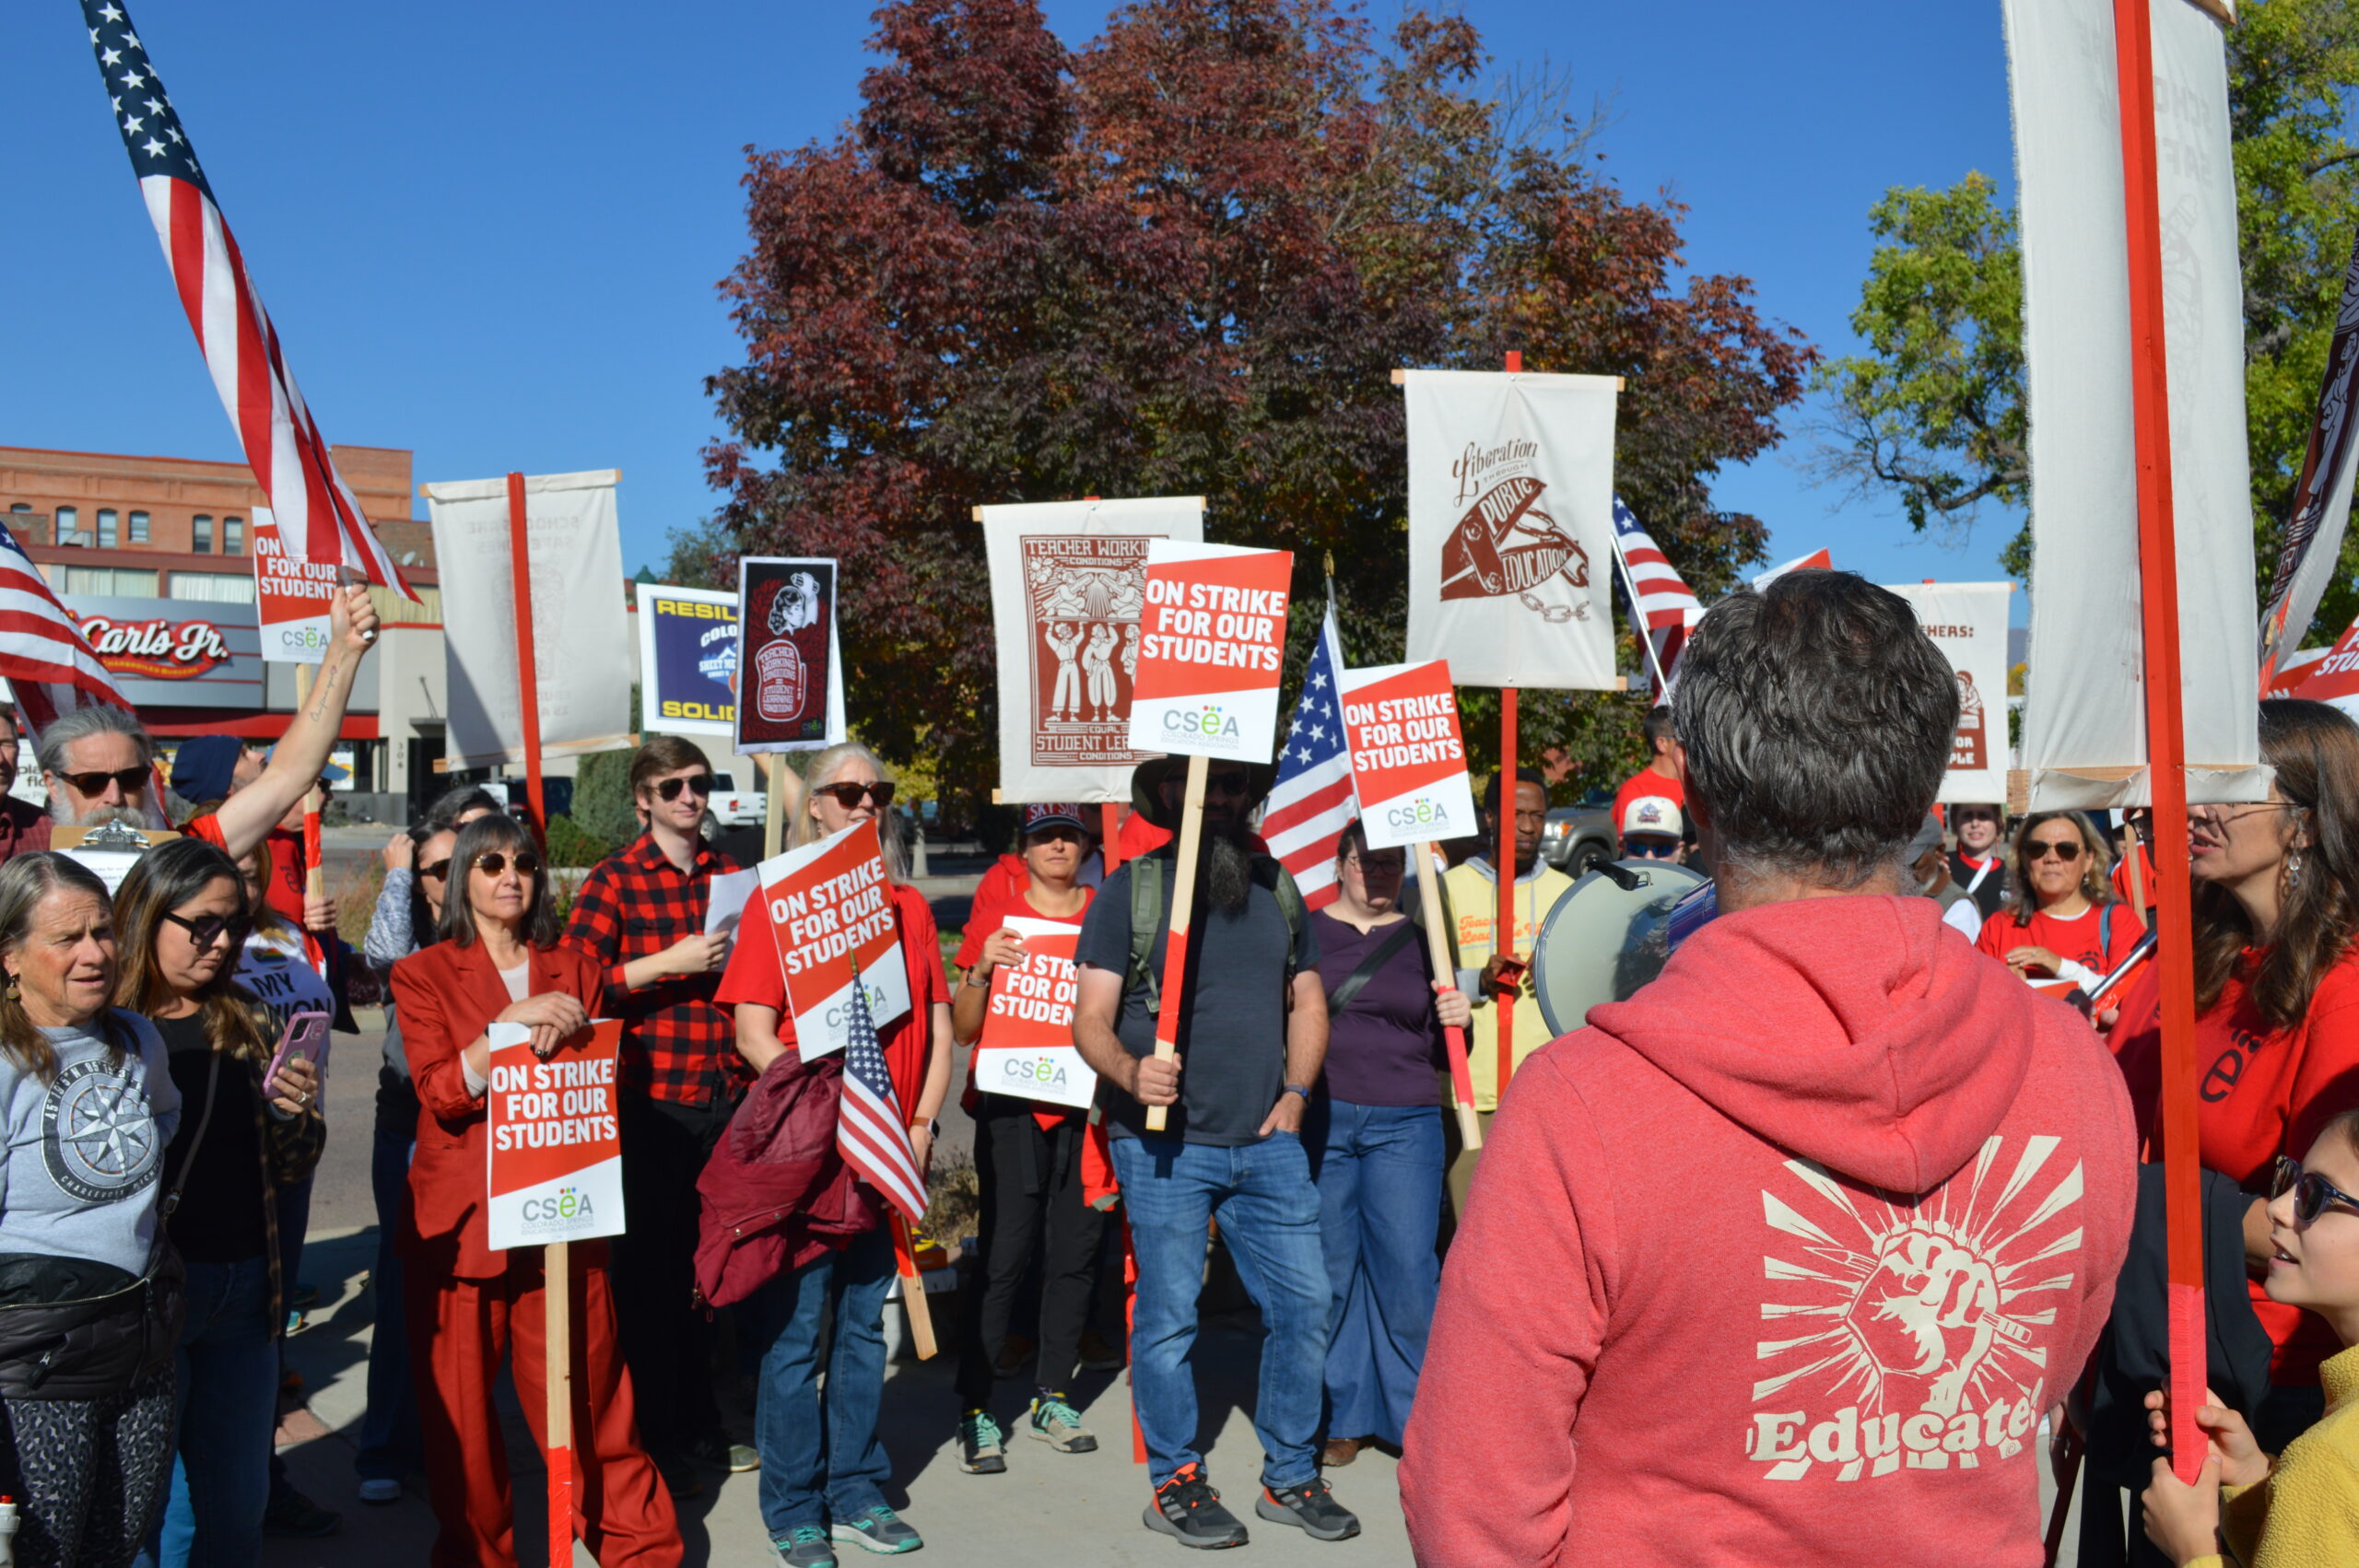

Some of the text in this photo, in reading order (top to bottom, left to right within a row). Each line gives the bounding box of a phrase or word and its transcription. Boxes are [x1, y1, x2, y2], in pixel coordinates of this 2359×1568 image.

[1452, 439, 1538, 508] Liberation
[1483, 463, 1529, 484] THROUGH
[1478, 478, 1532, 535] PUBLIC
[256, 536, 281, 556] ON
[1026, 539, 1093, 556] TEACHER
[1069, 557, 1122, 567] CONDITIONS
[266, 557, 337, 582] FOR OUR
[1502, 548, 1567, 592] EDUCATION
[261, 577, 337, 601] STUDENT
[1146, 579, 1286, 617] ON STRIKE
[80, 618, 229, 661] Carl's Jr.
[1157, 607, 1274, 644] FOR OUR
[1143, 634, 1280, 673] STUDENTS
[1344, 693, 1455, 727] ON STRIKE
[1036, 735, 1102, 751] STUDENT
[1088, 725, 1120, 734] EQUAL
[1359, 717, 1452, 748] FOR OUR
[1079, 752, 1133, 761] CONDITIONS
[1354, 739, 1463, 772] STUDENTS
[1030, 802, 1055, 820] SKY
[770, 855, 886, 924] ON STRIKE
[790, 885, 885, 946] FOR OUR
[785, 907, 894, 975] STUDENTS
[1033, 954, 1079, 982] STR
[250, 973, 296, 997] MY
[1005, 972, 1052, 1000] FOR
[491, 1059, 615, 1093] ON STRIKE
[506, 1087, 608, 1121] FOR OUR
[495, 1116, 617, 1152] STUDENTS
[1749, 1377, 2044, 1464] Educate!
